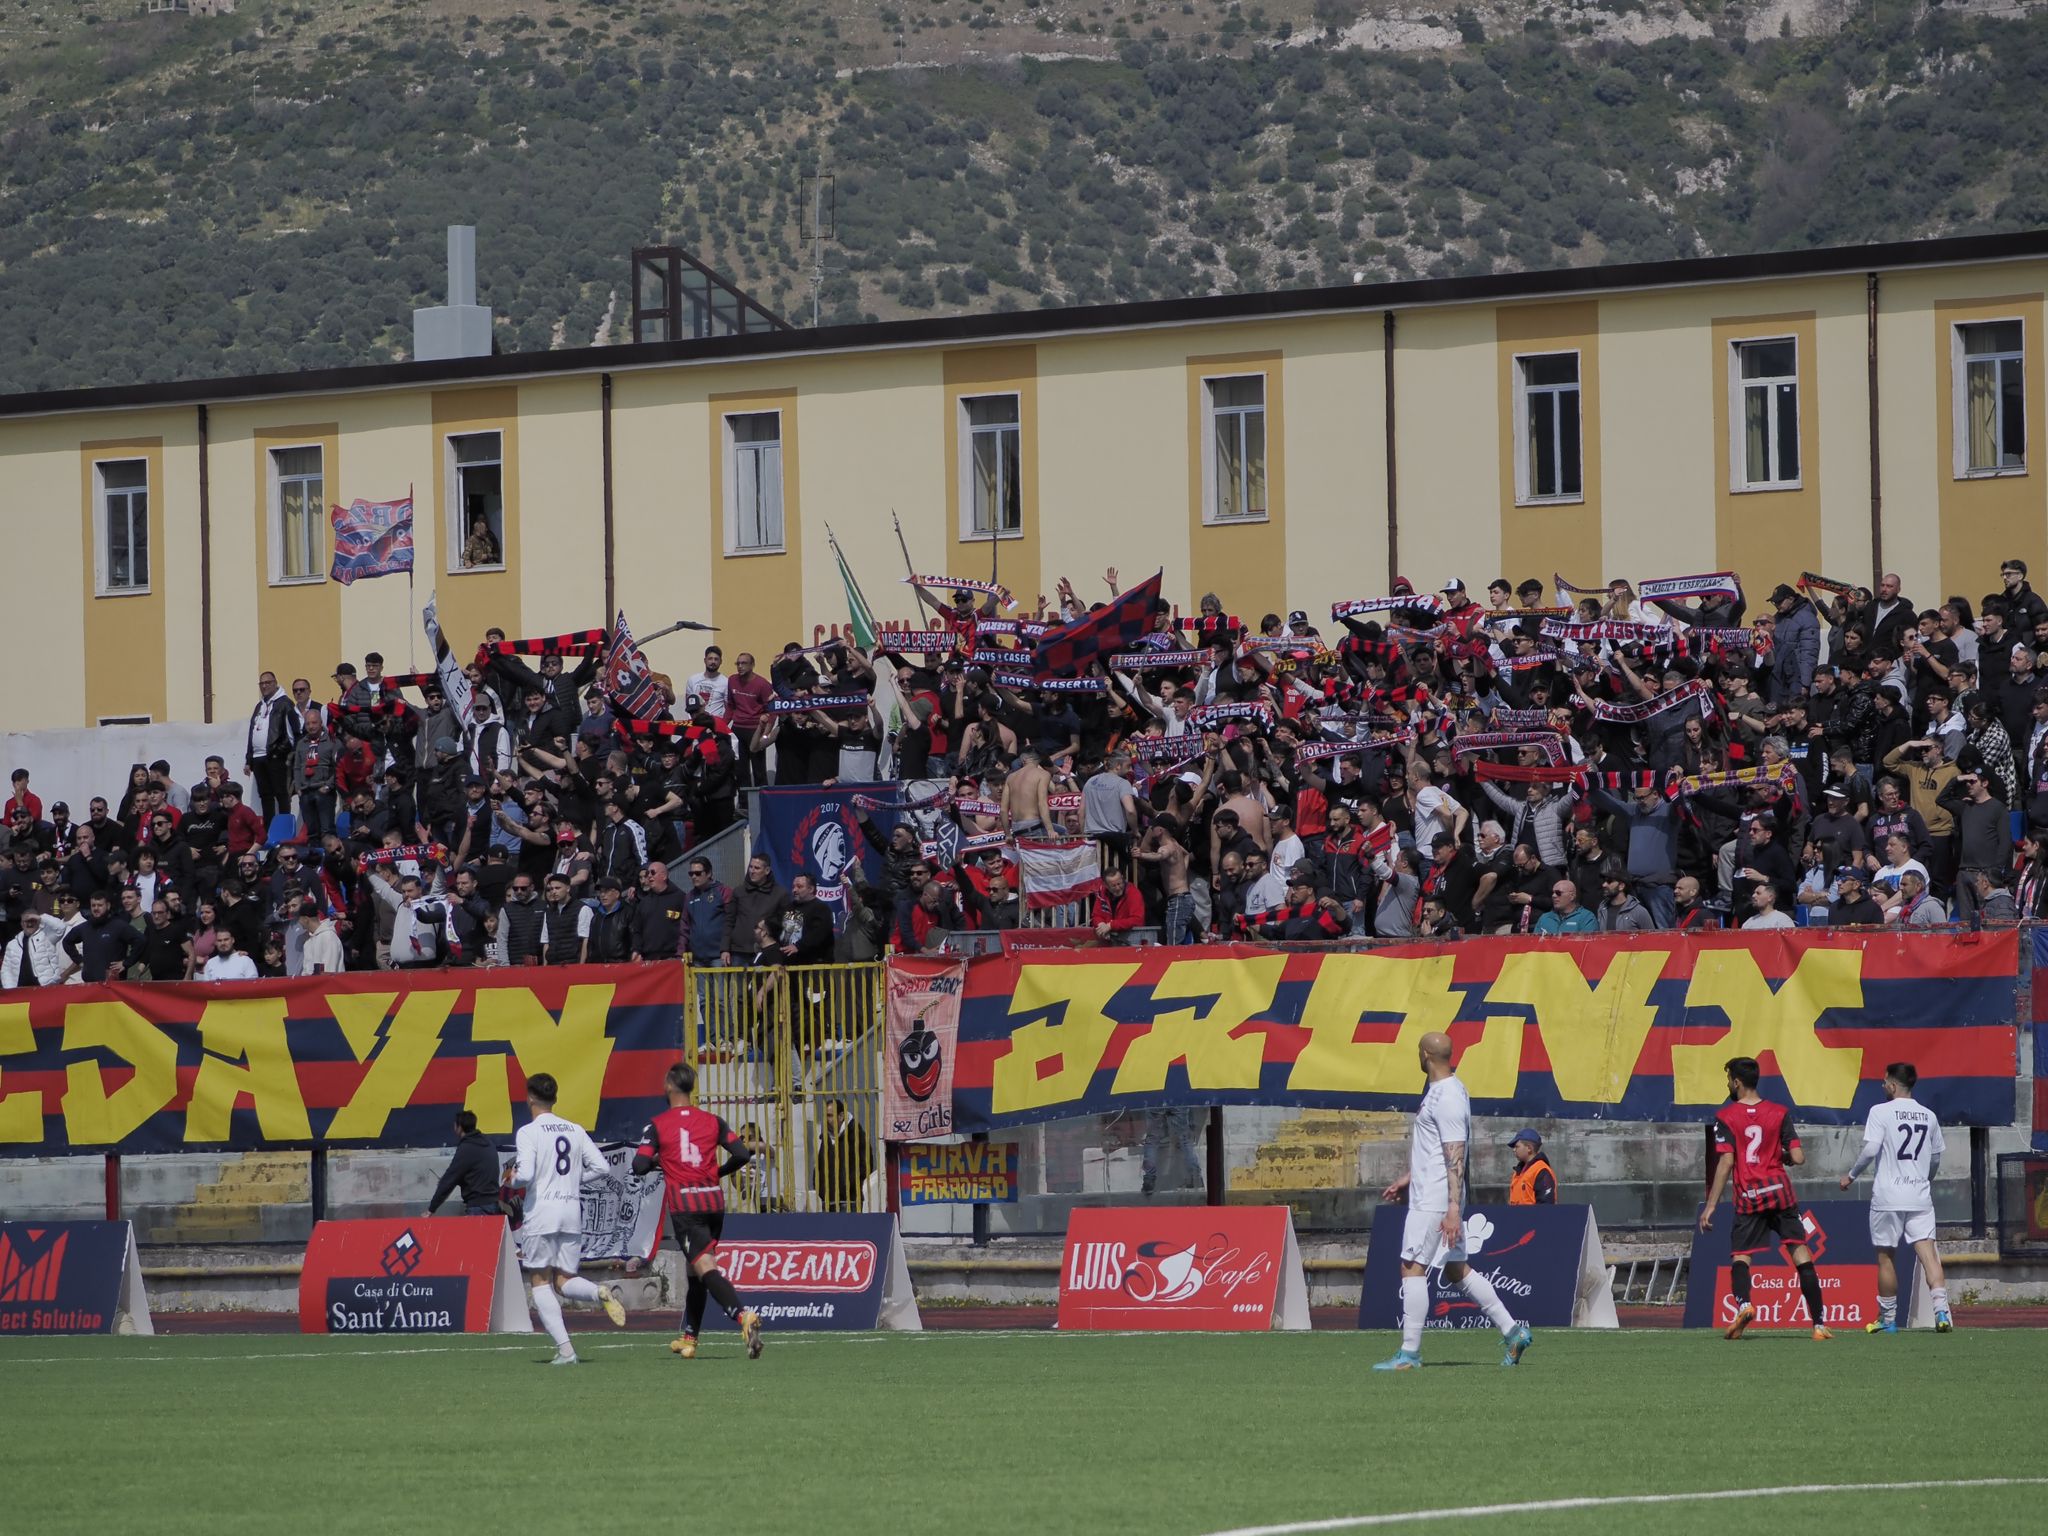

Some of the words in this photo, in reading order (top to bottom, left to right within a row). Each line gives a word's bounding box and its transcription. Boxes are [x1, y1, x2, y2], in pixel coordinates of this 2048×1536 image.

[924, 575, 998, 592] CASERTANA
[1335, 594, 1434, 618] CASERTA
[881, 632, 910, 647] MAGICA
[911, 632, 956, 647] CASERTANA
[973, 650, 996, 662] BOYS
[1003, 653, 1031, 664] CASER
[1518, 652, 1557, 665] CASERTANA
[1001, 675, 1030, 687] BOYS
[1042, 679, 1098, 689] CASERTA
[1302, 744, 1332, 757] FORZA
[820, 802, 840, 813] 2017
[360, 847, 416, 865] CASERTANA
[992, 947, 1865, 1115] BRONX
[918, 1104, 951, 1134] Girls
[1895, 1110, 1928, 1122] TURCHETTA
[680, 1127, 703, 1168] 4
[1744, 1124, 1763, 1164] 2
[1897, 1123, 1928, 1160] 27
[555, 1135, 571, 1176] 8
[909, 1142, 1008, 1178] CURVA
[911, 1176, 1009, 1202] PARADISO
[714, 1249, 864, 1282] SIPREMIX
[1068, 1241, 1126, 1291] LUIS
[354, 1282, 383, 1298] Casa
[387, 1282, 400, 1297] di
[402, 1282, 434, 1297] Cura
[1751, 1273, 1784, 1288] Casa
[1818, 1275, 1841, 1288] ura
[0, 1310, 27, 1330] ect
[32, 1308, 103, 1330] Solution
[332, 1300, 452, 1330] Sant'Anna
[1722, 1292, 1862, 1323] Snt'Ana
